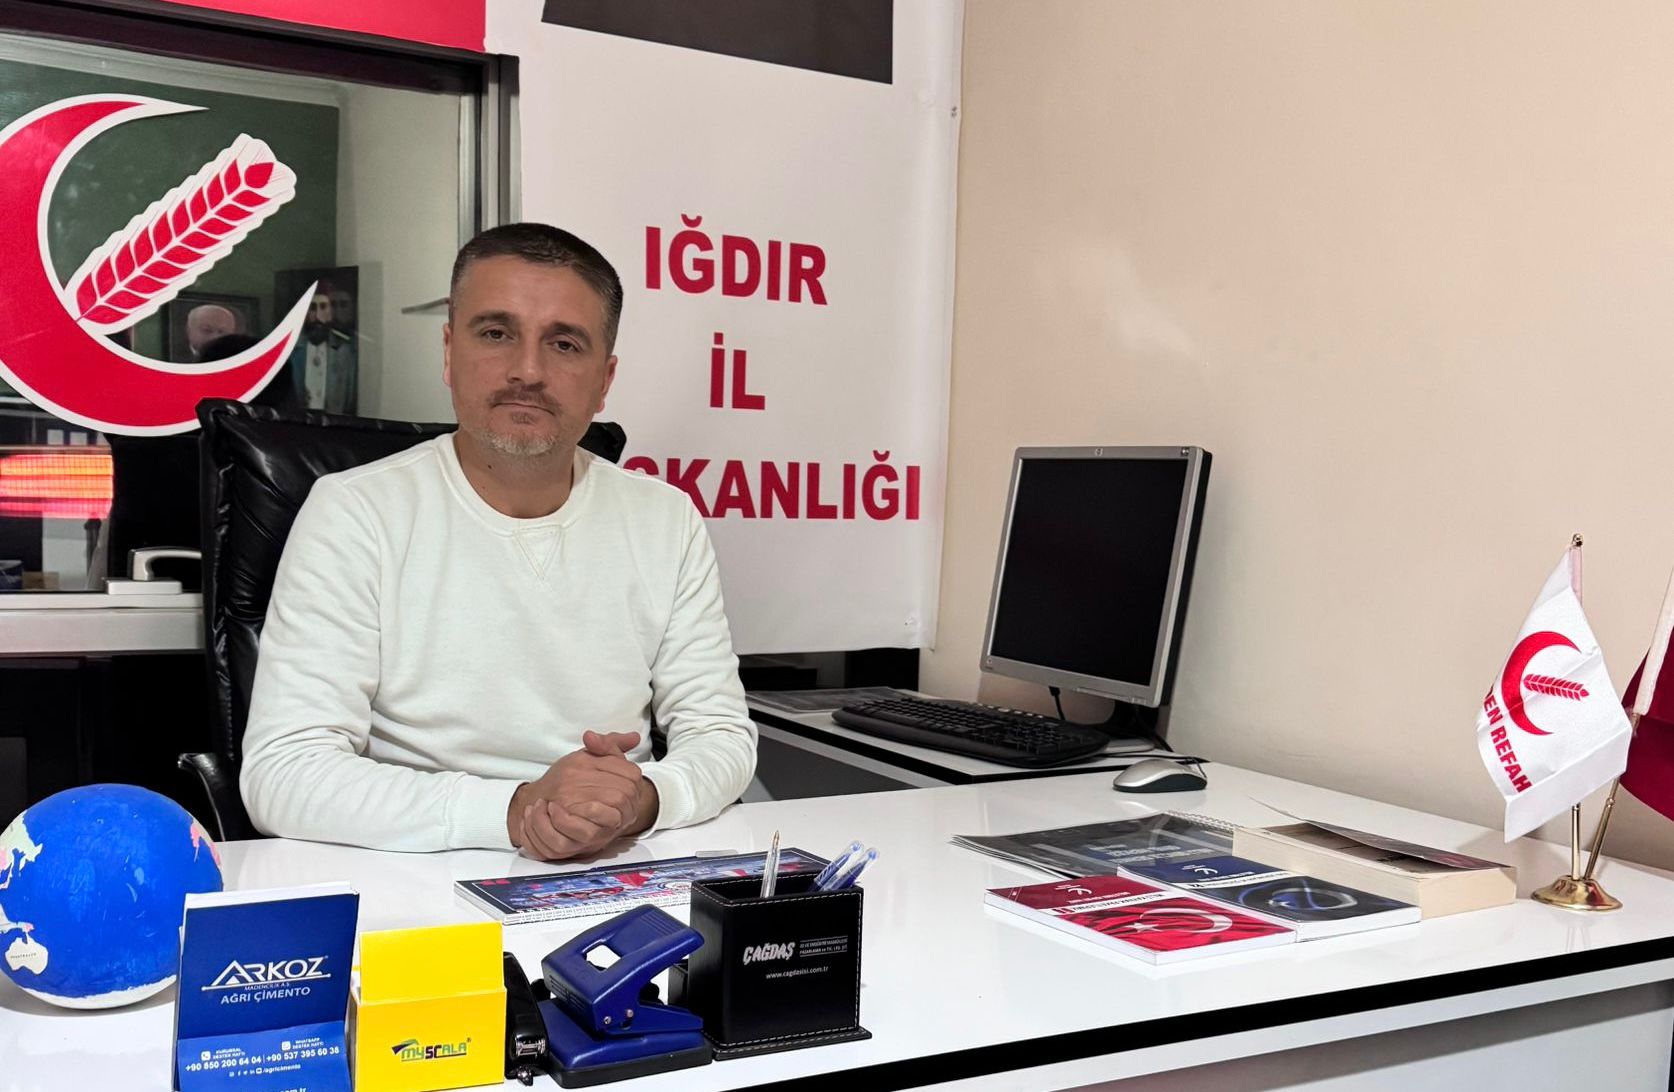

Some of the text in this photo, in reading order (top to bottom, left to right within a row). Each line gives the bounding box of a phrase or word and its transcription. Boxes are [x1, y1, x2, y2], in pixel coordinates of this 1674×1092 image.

[646, 213, 828, 305] IĞDIR
[710, 332, 765, 410] İL
[1490, 725, 1533, 793] REFAH
[743, 942, 796, 965] ÇAĞDAŞ
[211, 956, 325, 987] ARKOZ
[766, 966, 829, 979] www.cagdasisi.com.tr
[220, 986, 311, 1004] AĞRI ÇİMENTO
[185, 1063, 202, 1072] +90
[221, 1059, 237, 1068] 200
[251, 1056, 262, 1064] 04
[266, 1053, 282, 1062] +90
[284, 1051, 298, 1060] 537
[300, 1049, 316, 1058] 395
